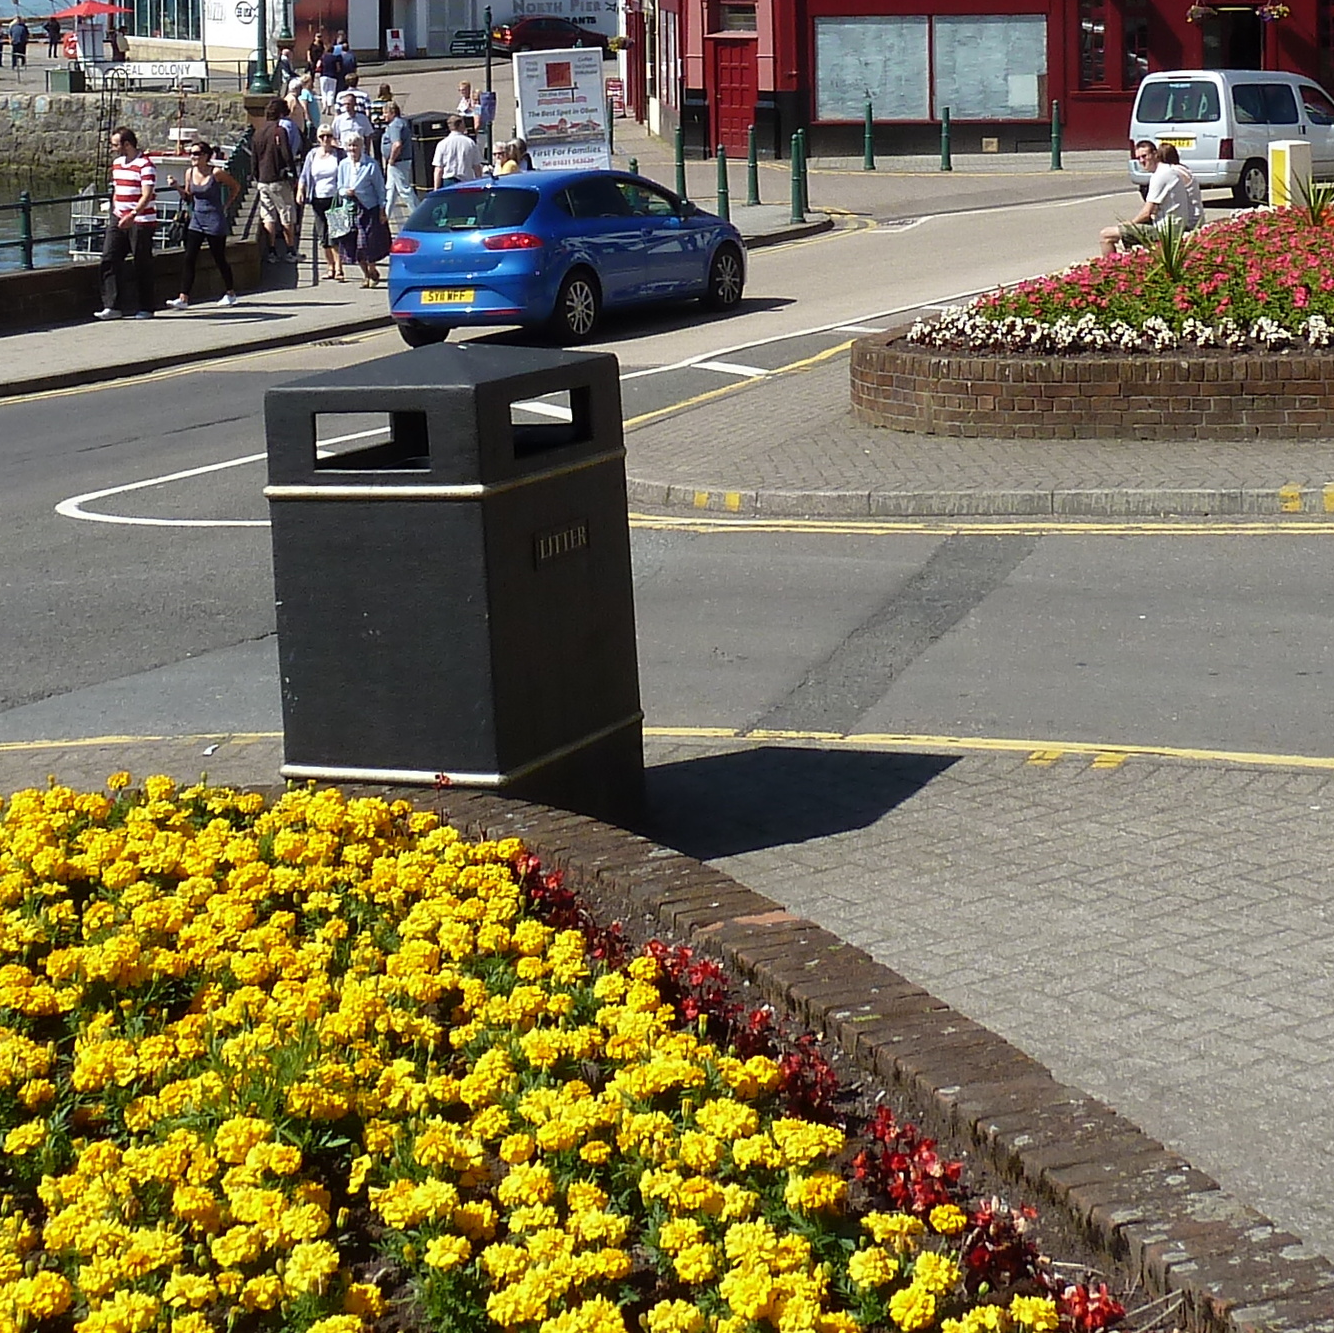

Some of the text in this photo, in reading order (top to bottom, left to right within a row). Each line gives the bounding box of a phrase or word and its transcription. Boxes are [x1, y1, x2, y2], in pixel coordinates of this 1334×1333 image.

[151, 64, 191, 76] COLONY
[528, 110, 540, 118] The
[541, 109, 555, 117] Best
[533, 145, 602, 158] First For Families
[540, 526, 587, 559] LITTER
